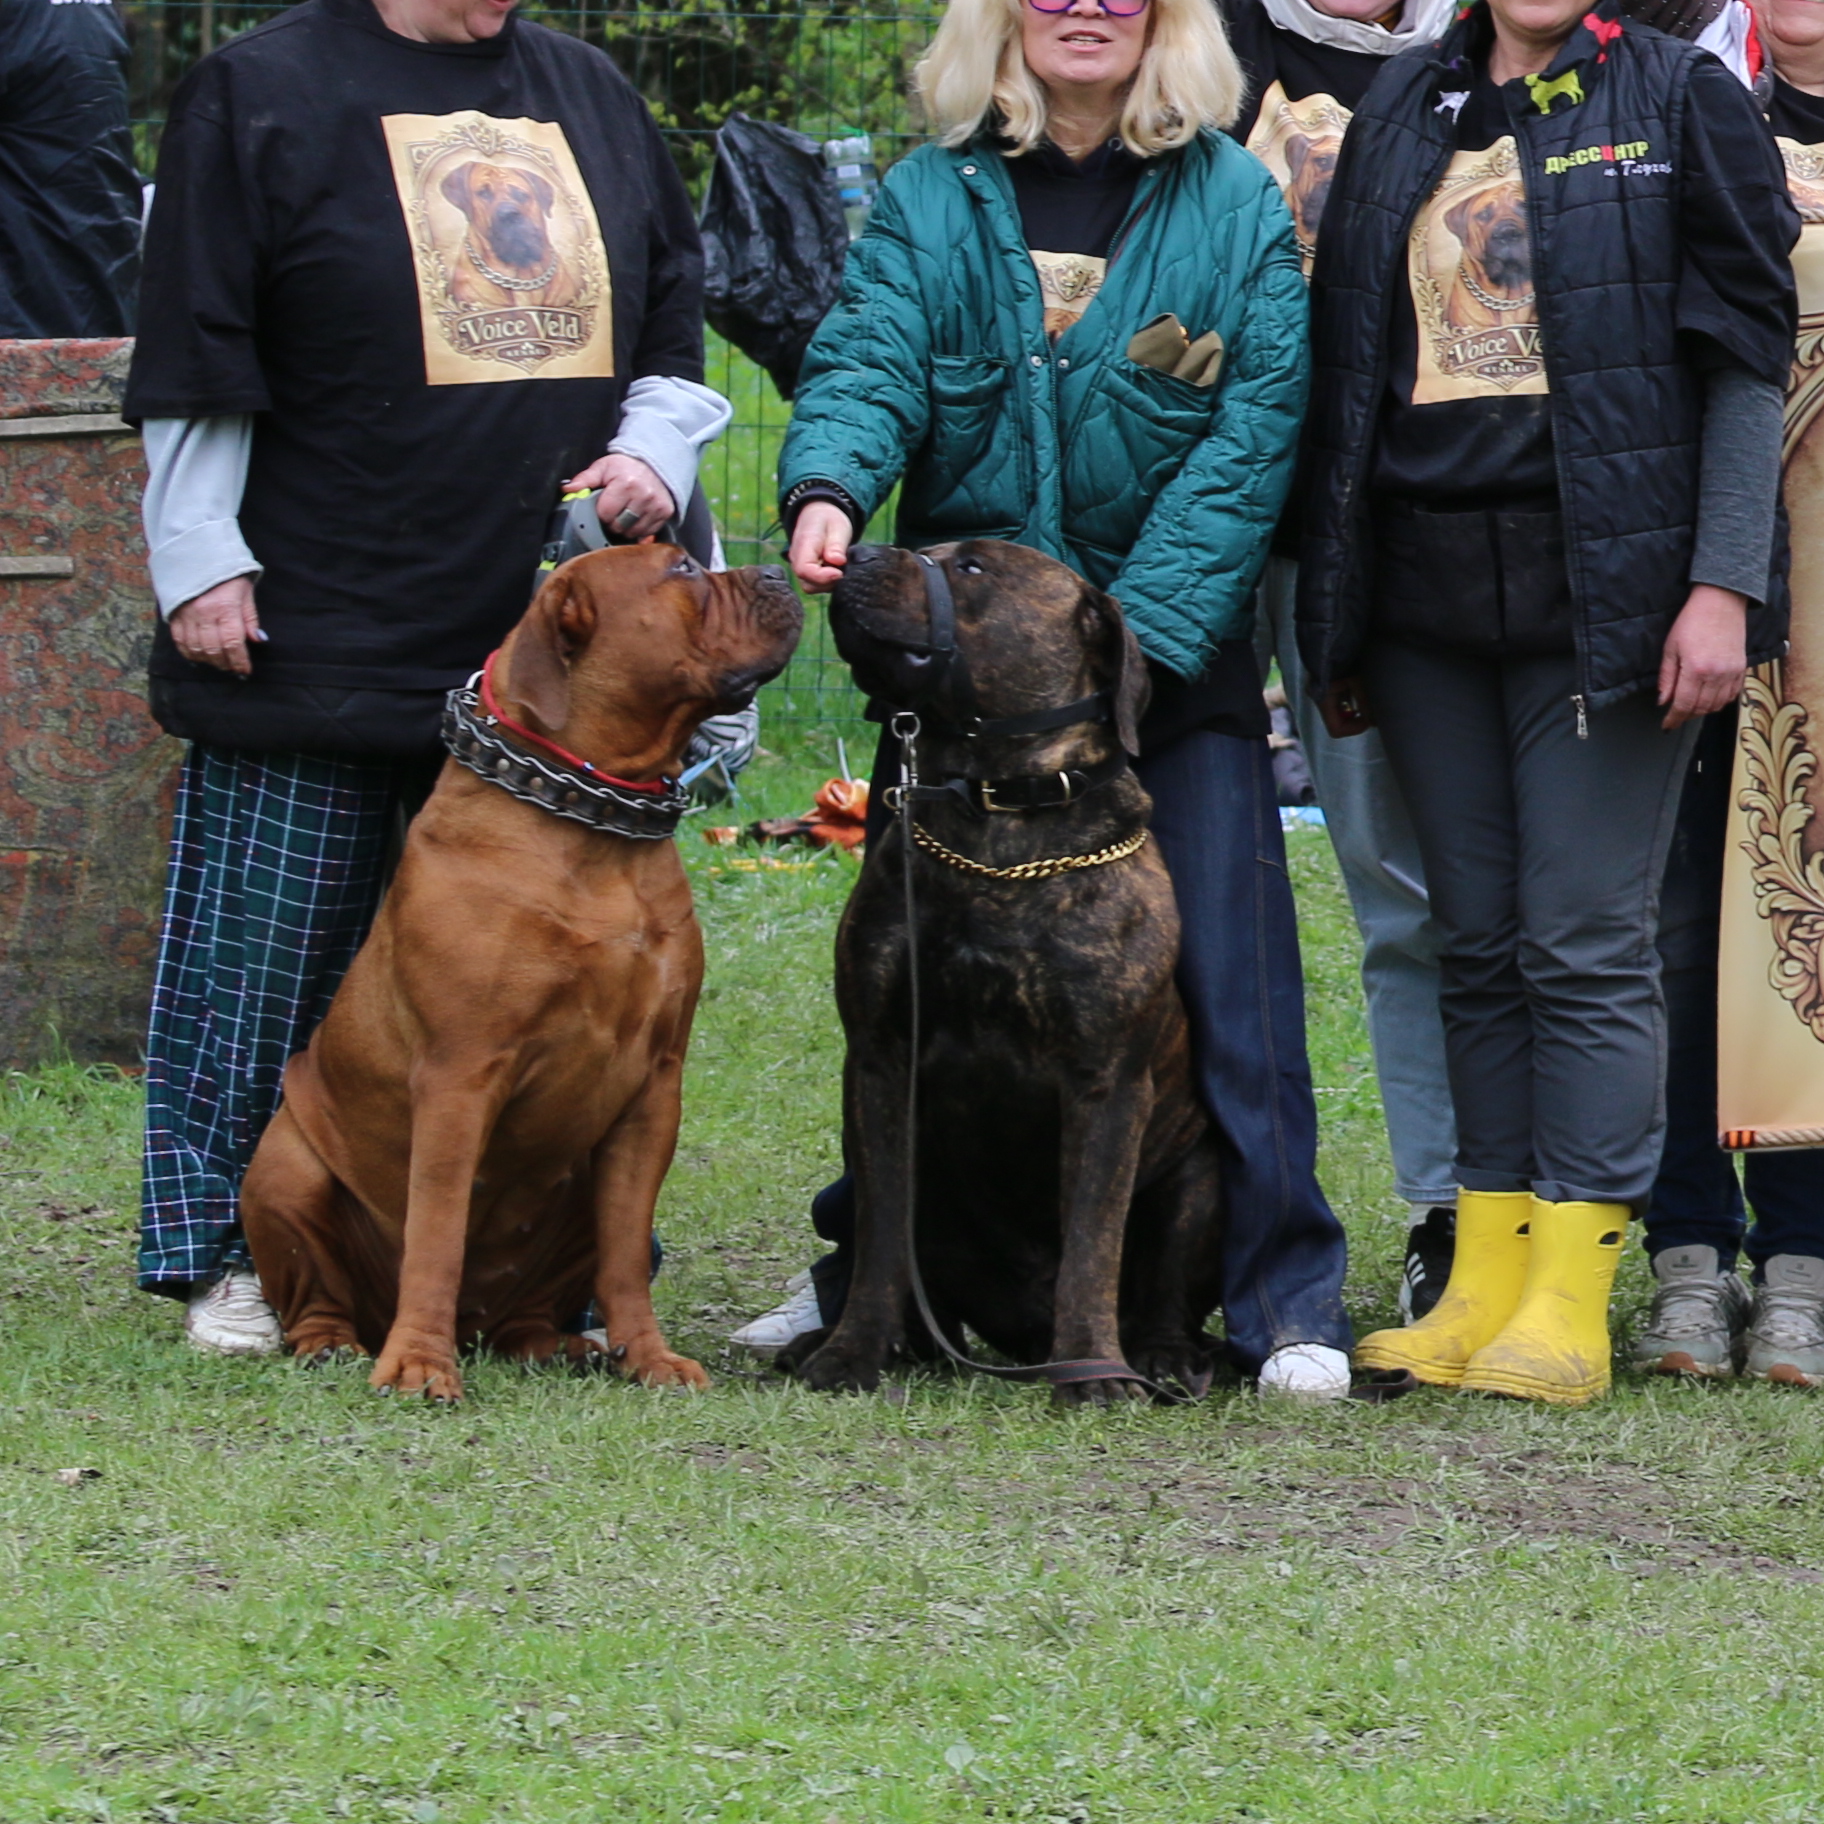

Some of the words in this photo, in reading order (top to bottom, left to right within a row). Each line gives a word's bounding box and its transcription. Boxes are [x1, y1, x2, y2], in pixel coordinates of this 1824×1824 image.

[458, 317, 528, 344] Voice
[525, 311, 580, 339] Veld
[1448, 337, 1508, 364] Voice
[1507, 328, 1543, 358] Ve
